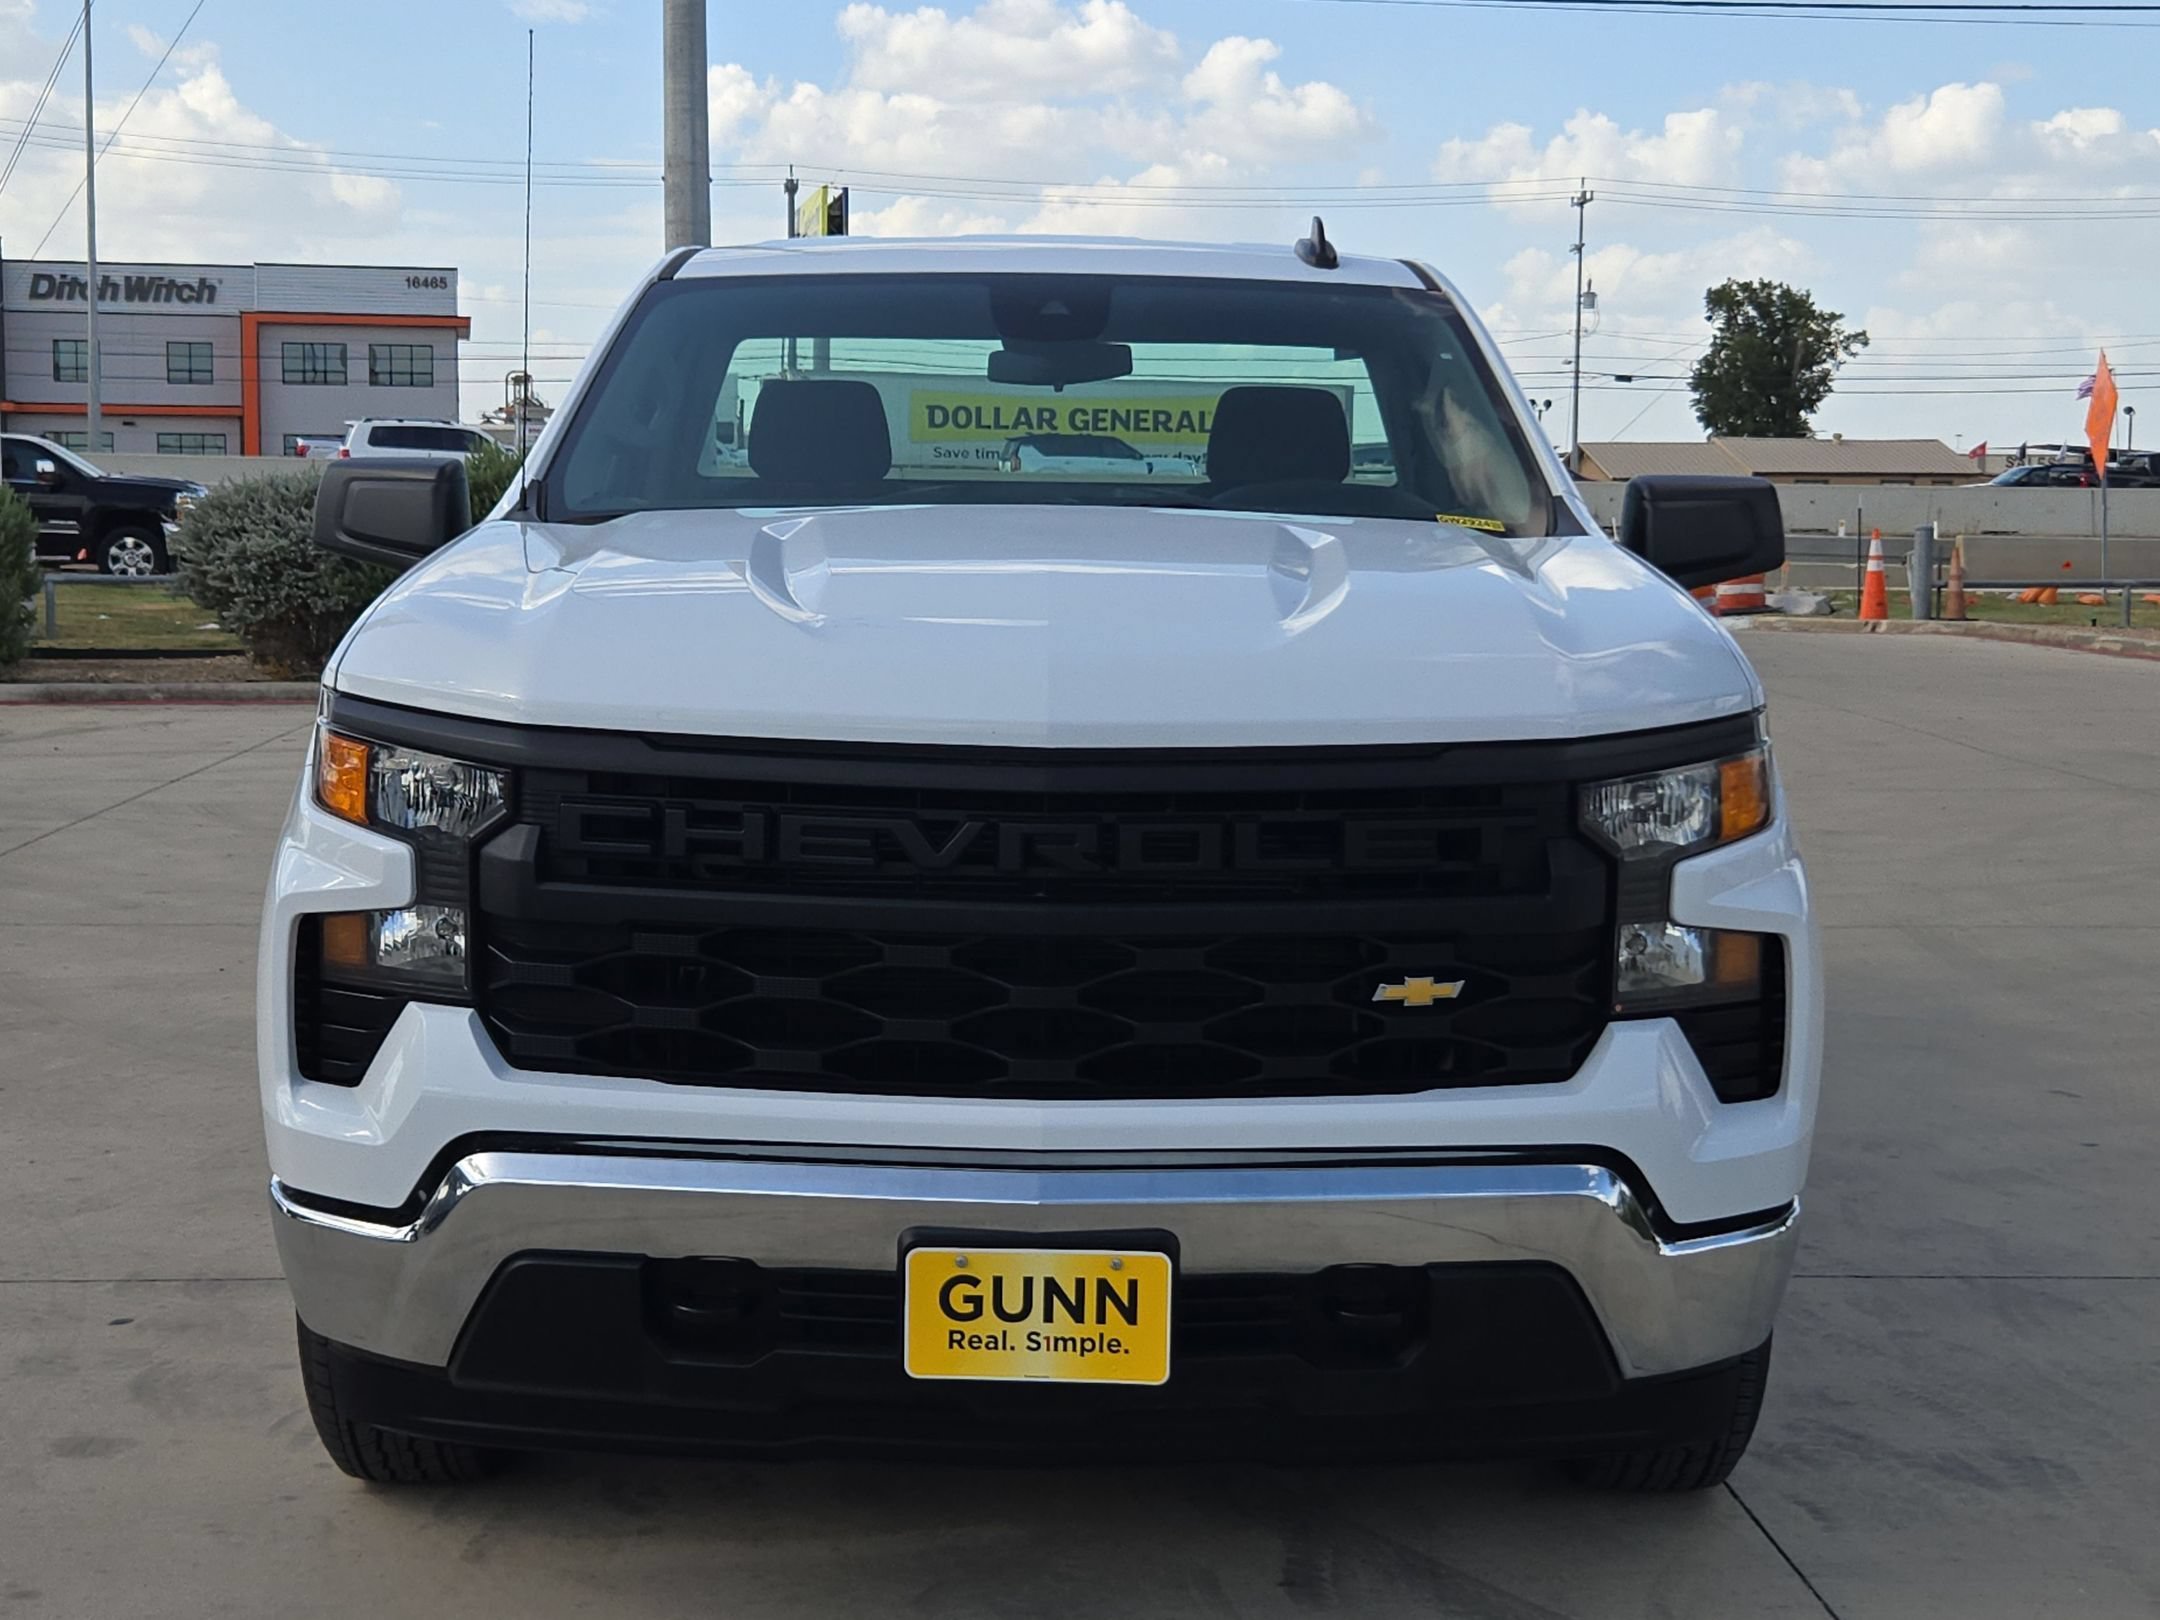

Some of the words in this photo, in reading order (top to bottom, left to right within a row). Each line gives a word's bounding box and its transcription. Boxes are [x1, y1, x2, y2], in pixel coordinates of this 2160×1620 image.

[124, 276, 217, 304] Witch
[925, 404, 1058, 431] DOLLAR
[1068, 407, 1212, 434] GENERAL
[933, 446, 970, 460] Save
[975, 446, 1001, 460] tim
[557, 794, 1537, 873] CHEVROLET
[939, 1274, 1139, 1326] GUNN
[948, 1329, 1016, 1351] Real.
